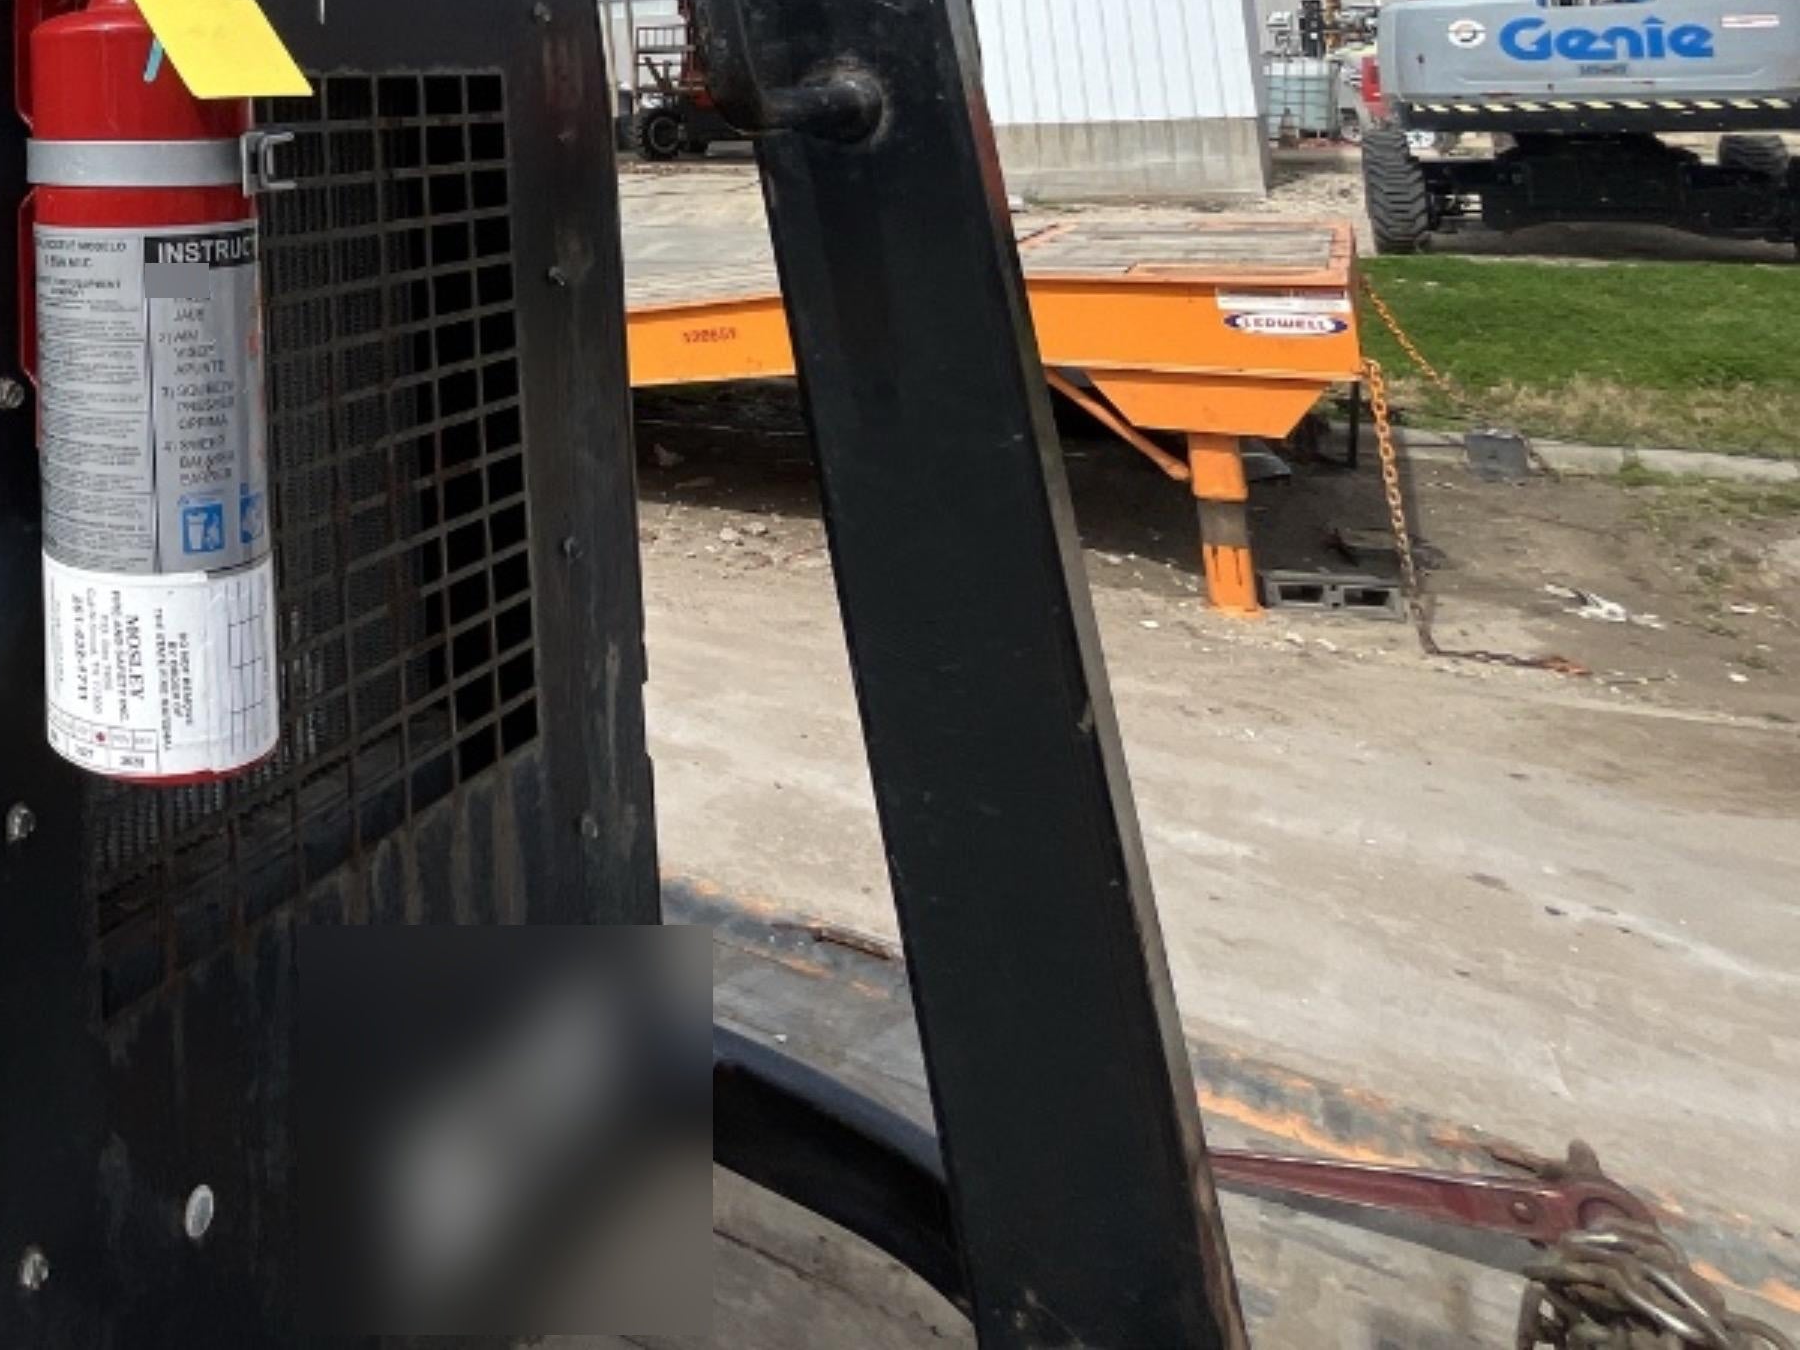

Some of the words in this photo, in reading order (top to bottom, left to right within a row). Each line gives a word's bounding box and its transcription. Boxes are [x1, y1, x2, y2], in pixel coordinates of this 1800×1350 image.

[1499, 15, 1714, 62] Genie
[1244, 316, 1327, 331] LEDWELL
[125, 613, 146, 702] MOSLEY
